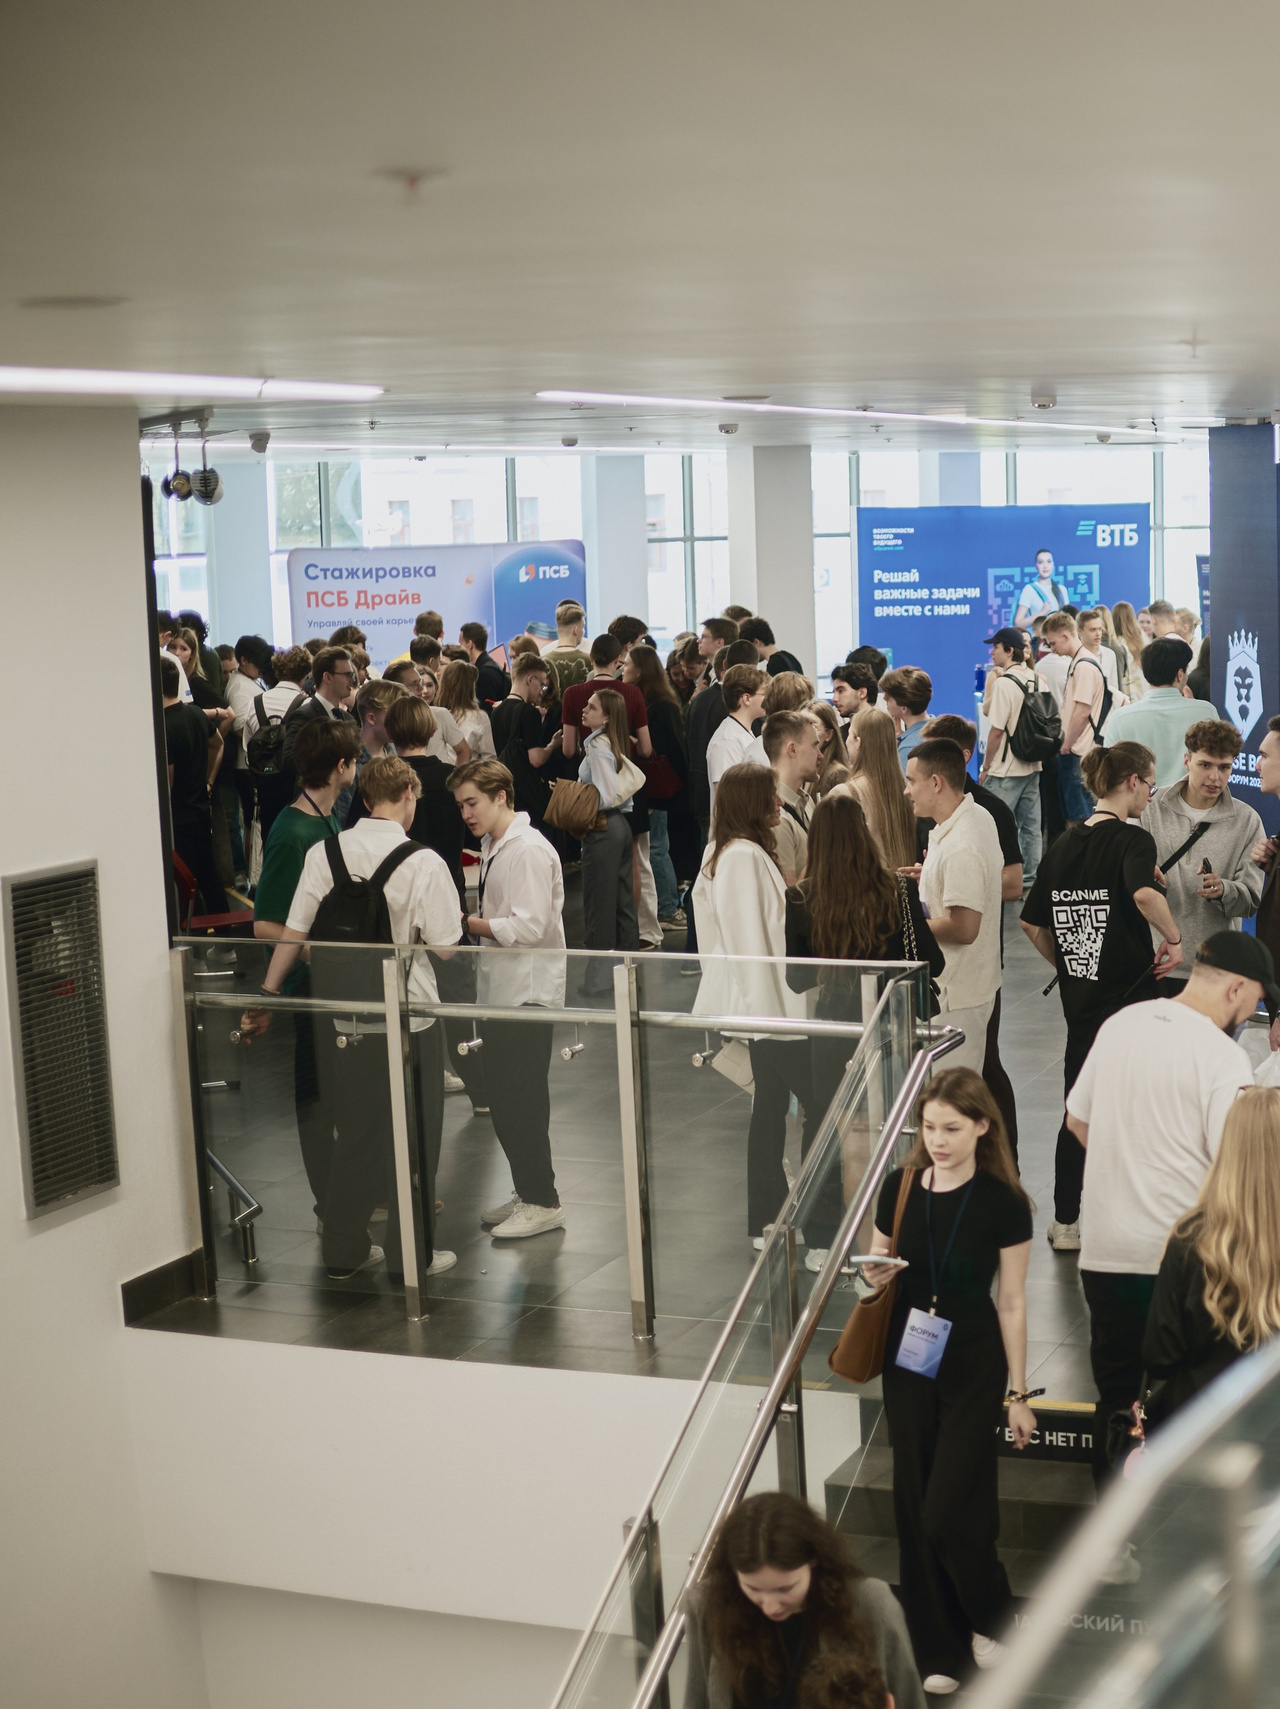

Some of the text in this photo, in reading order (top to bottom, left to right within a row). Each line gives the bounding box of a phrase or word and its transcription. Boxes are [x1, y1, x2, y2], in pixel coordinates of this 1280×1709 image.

[1096, 523, 1139, 547] ВТБ
[304, 563, 436, 584] Стажировка
[539, 565, 570, 579] ПСБ
[873, 569, 919, 583] Решай
[306, 589, 421, 610] ПСБ Драйв
[874, 587, 980, 601] важные задачи
[874, 604, 970, 617] вместе с нами
[307, 617, 415, 629] Управляй своей карье
[909, 1325, 939, 1340] ФОРУМ
[1004, 1427, 1041, 1444] ВС
[1045, 1431, 1077, 1447] НЕТ
[1081, 1434, 1093, 1448] П
